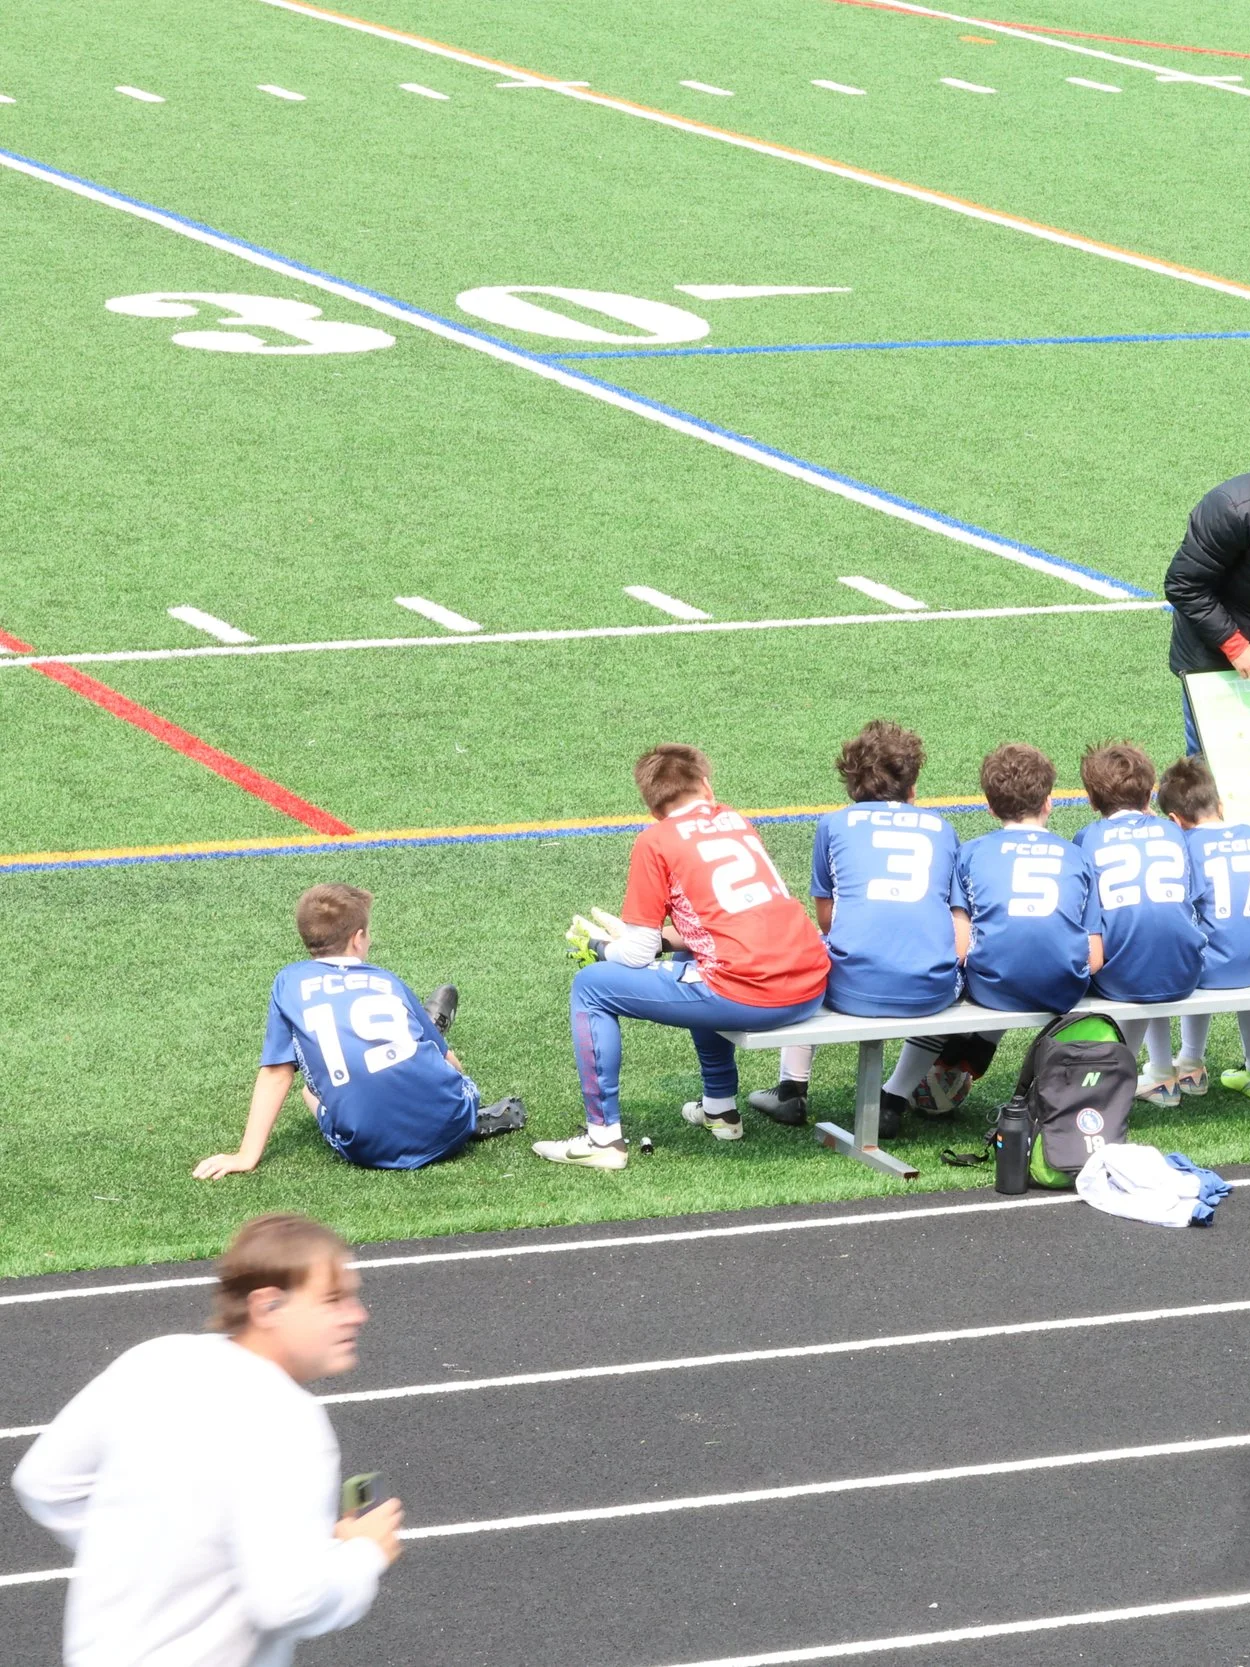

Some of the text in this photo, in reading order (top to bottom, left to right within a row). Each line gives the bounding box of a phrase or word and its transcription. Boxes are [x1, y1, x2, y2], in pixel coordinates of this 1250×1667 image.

[105, 285, 711, 354] 30
[696, 834, 791, 914] 21
[866, 830, 934, 902] 3
[1008, 857, 1062, 917] 5
[1094, 840, 1186, 911] 22
[303, 994, 418, 1088] 19
